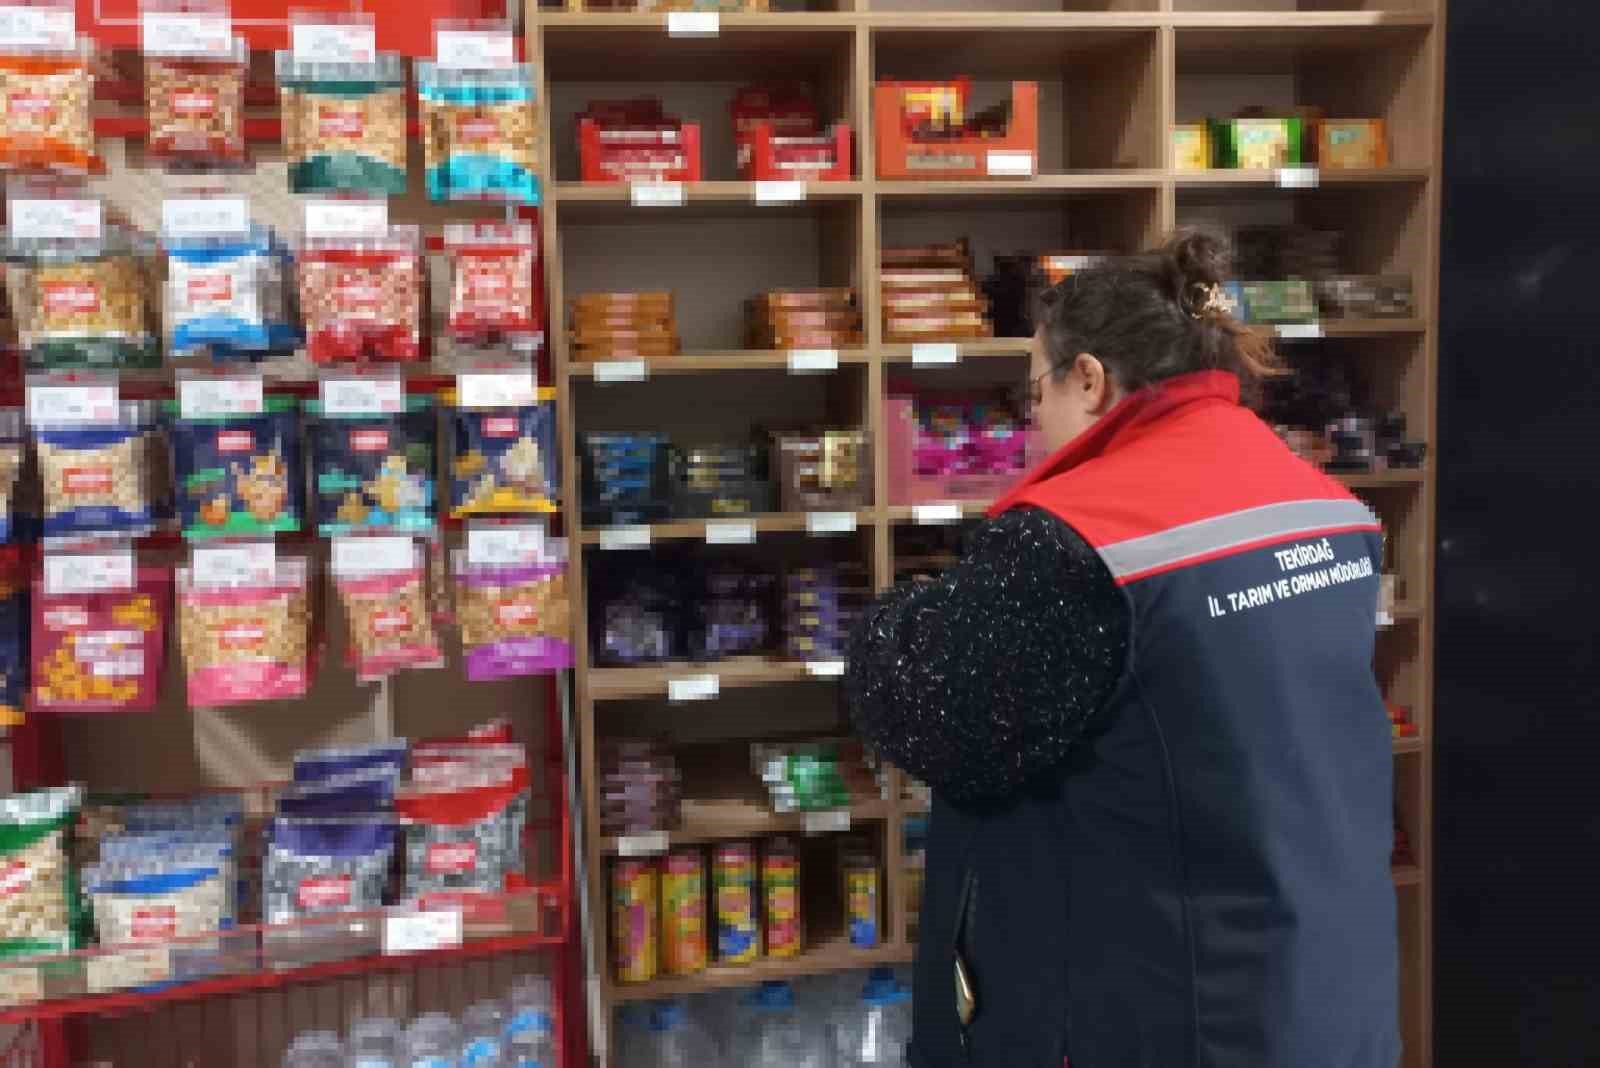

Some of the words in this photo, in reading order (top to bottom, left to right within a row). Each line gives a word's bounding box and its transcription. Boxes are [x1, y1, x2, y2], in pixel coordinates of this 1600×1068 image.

[1275, 538, 1334, 571] TEKİRDAĞ
[1208, 595, 1225, 617] İL
[1227, 585, 1273, 612] TARIM
[1273, 579, 1291, 600] VE
[1292, 570, 1329, 595] ORMAN
